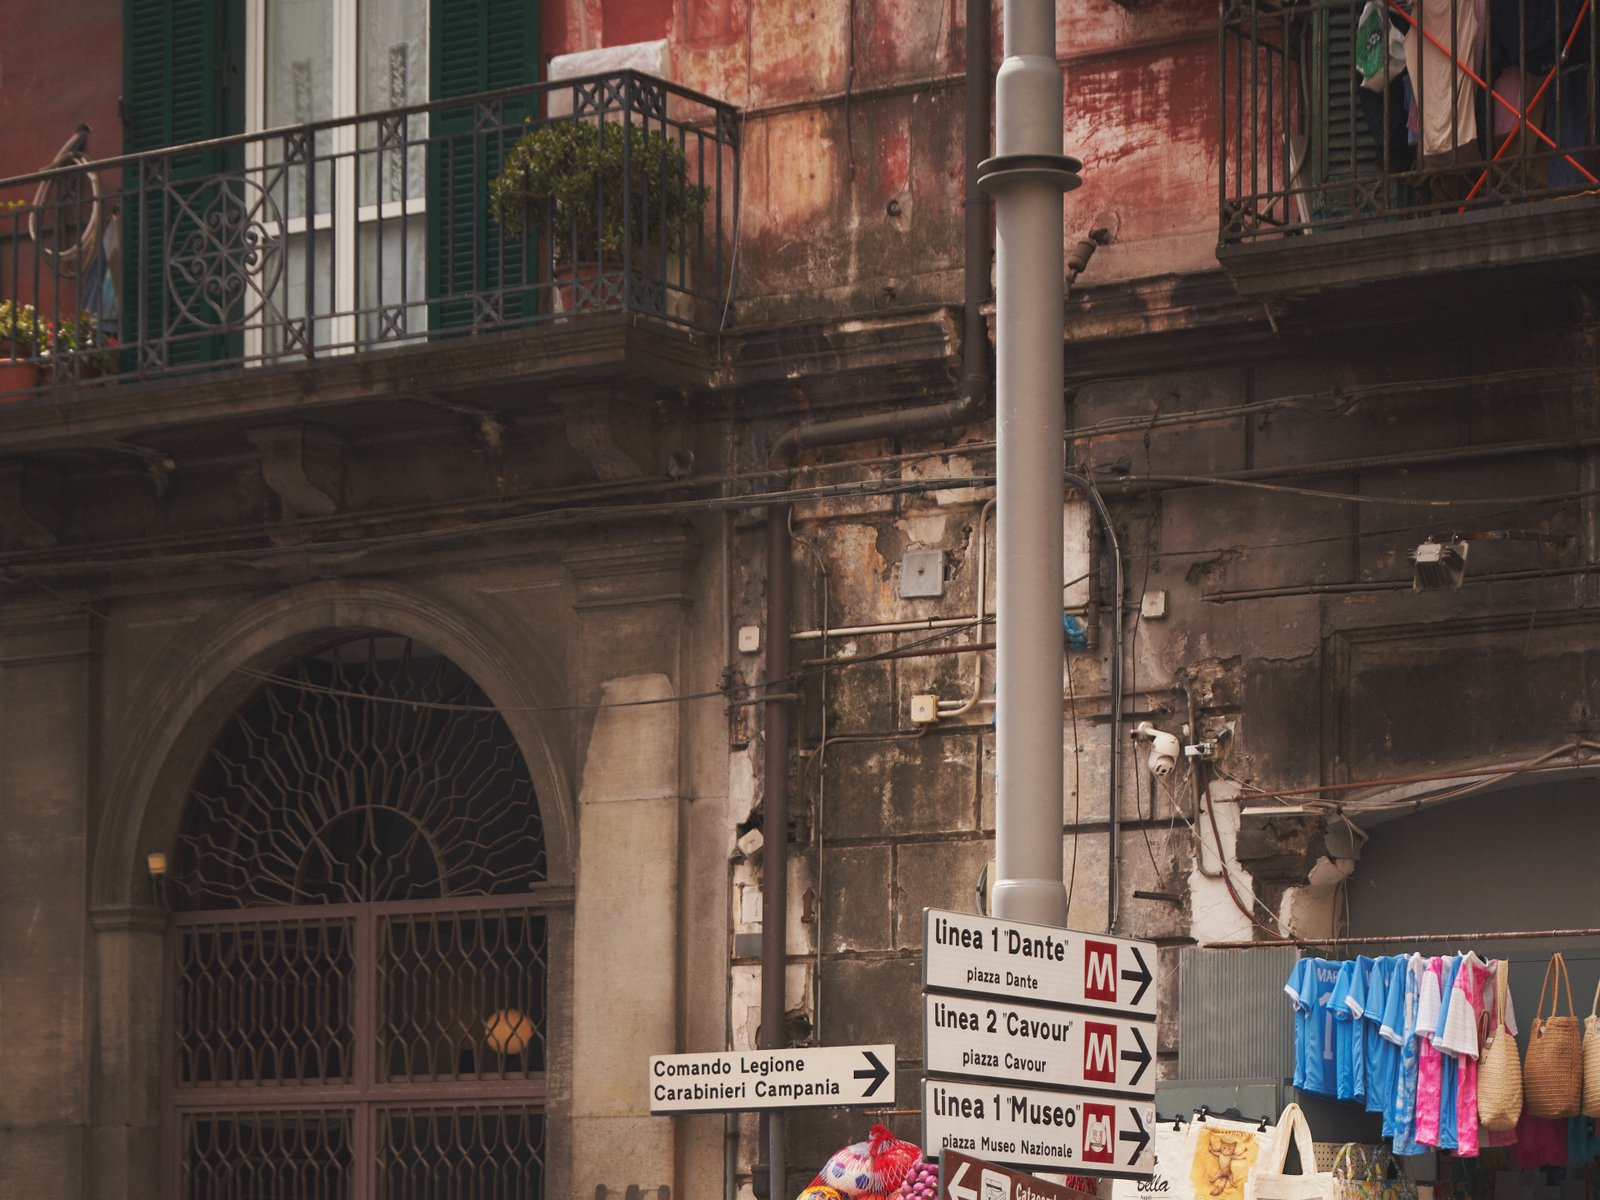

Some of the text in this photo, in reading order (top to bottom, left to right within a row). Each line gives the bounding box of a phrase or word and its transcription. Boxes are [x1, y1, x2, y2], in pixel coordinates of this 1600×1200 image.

[935, 918, 1069, 962] linea 1 "Dante"
[967, 967, 1038, 990] piazza Dante
[1086, 951, 1115, 993] M
[934, 1003, 1073, 1042] linea 2 "Cavour"
[654, 1057, 805, 1077] Comando Legione
[962, 1049, 1046, 1073] piazza Cavour
[1085, 1032, 1115, 1073] M
[654, 1078, 840, 1101] Carabinieri Campania
[933, 1087, 1081, 1128] linea 1 "Museo"
[942, 1134, 1073, 1159] piazza Museo Nazionale
